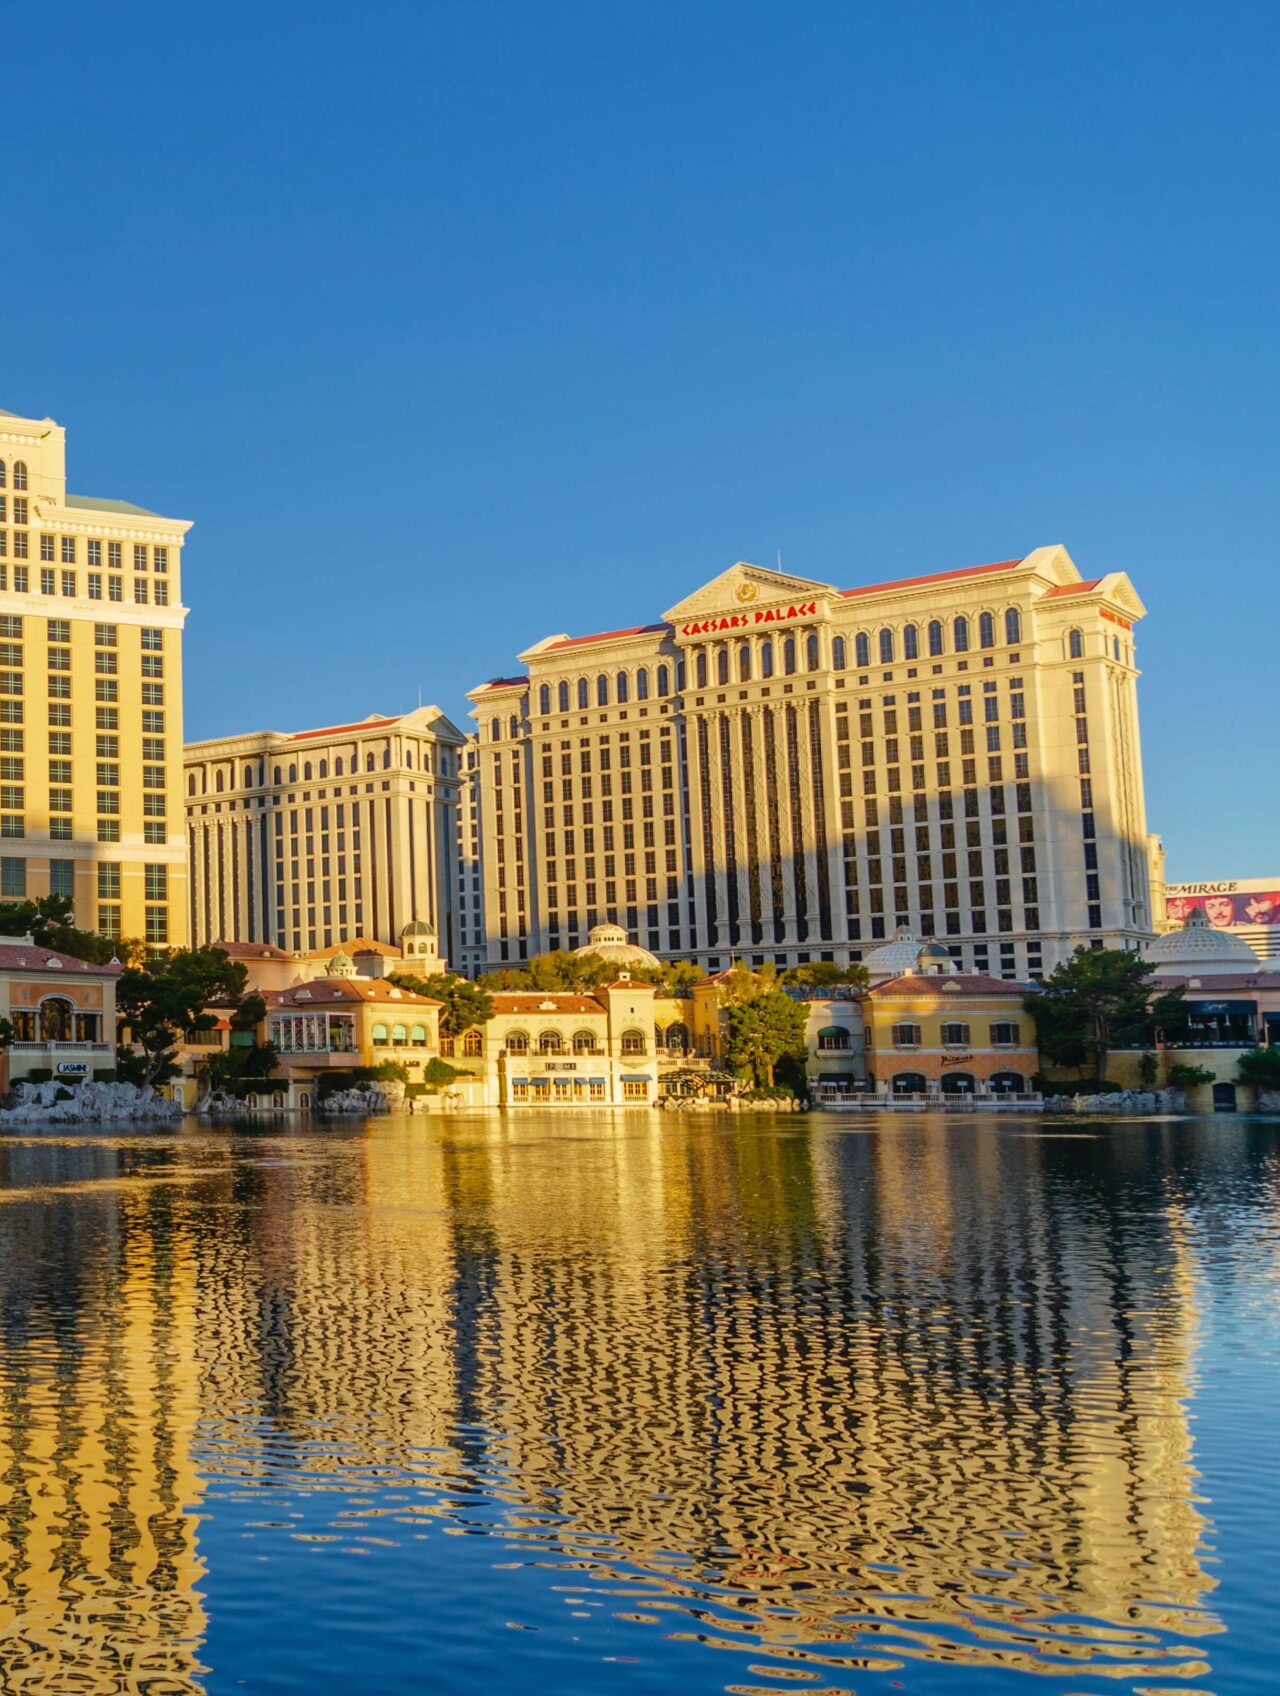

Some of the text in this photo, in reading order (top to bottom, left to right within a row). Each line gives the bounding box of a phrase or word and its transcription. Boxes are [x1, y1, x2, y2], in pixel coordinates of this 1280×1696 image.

[681, 602, 817, 636] CAESARS PALACE
[1177, 882, 1238, 894] MIRAGE
